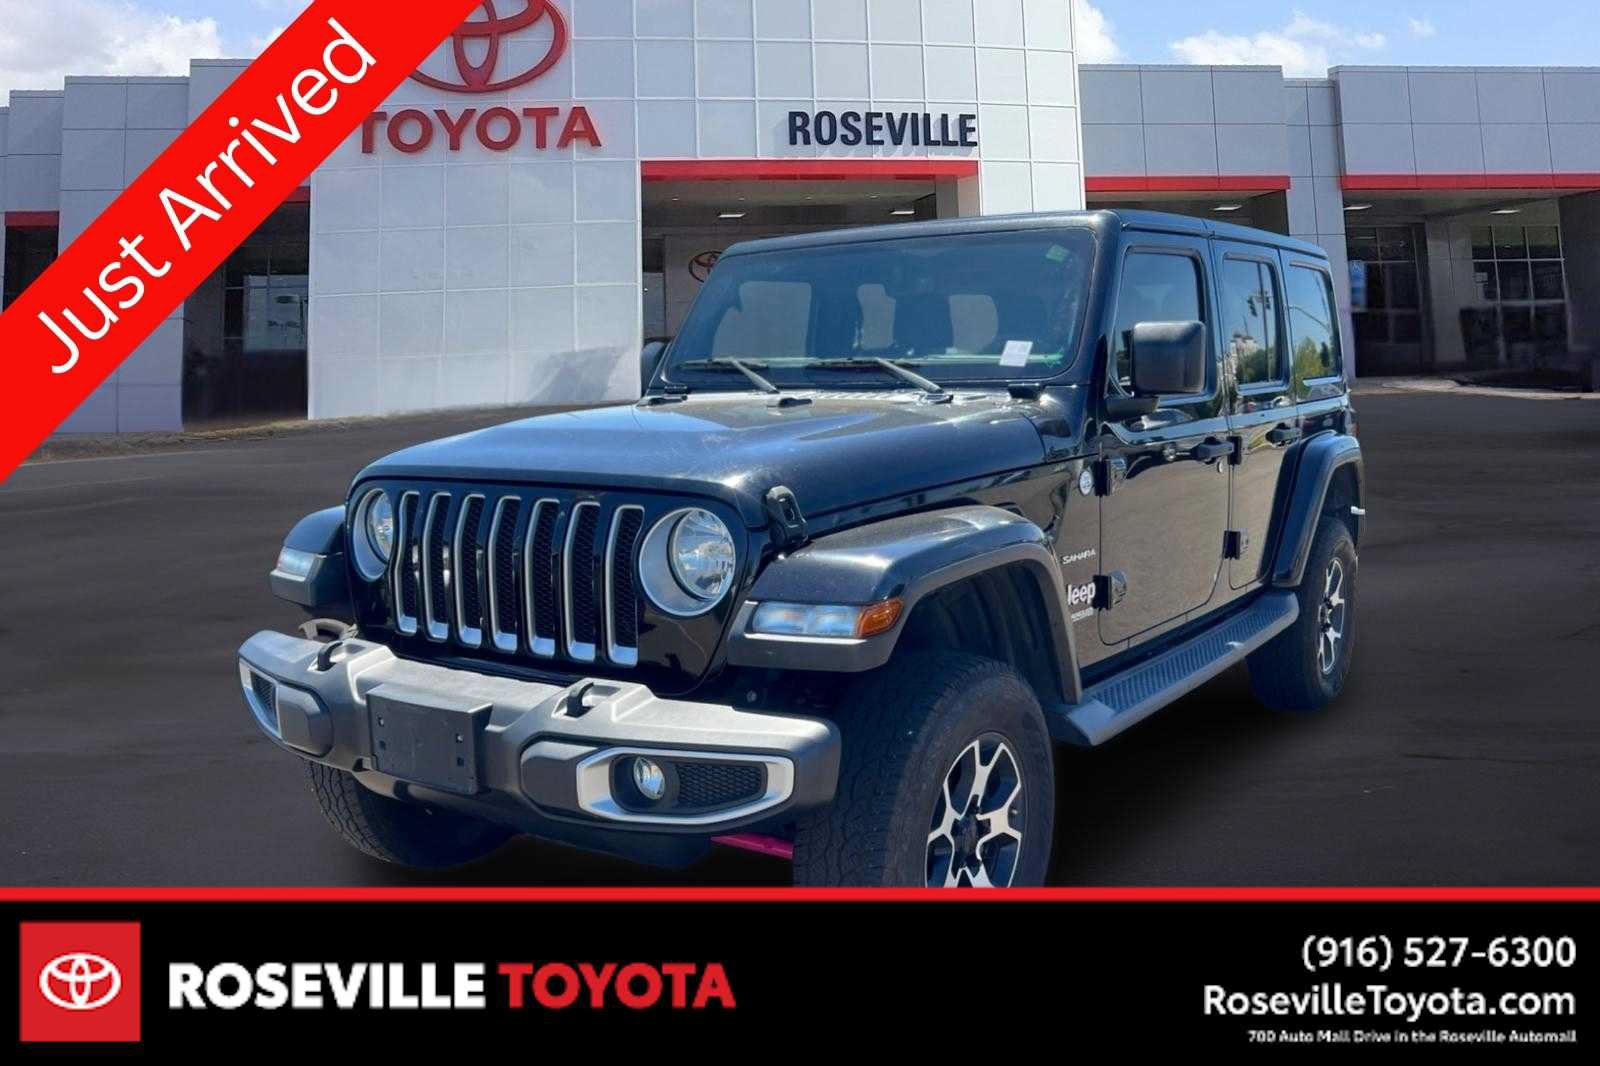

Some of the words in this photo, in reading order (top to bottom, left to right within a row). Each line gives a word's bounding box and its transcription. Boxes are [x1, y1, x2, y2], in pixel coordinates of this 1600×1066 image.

[361, 106, 602, 154] TOYOTA
[787, 111, 979, 147] ROSEVILLE
[1062, 548, 1096, 565] SAHARA
[1067, 582, 1096, 605] Jeep
